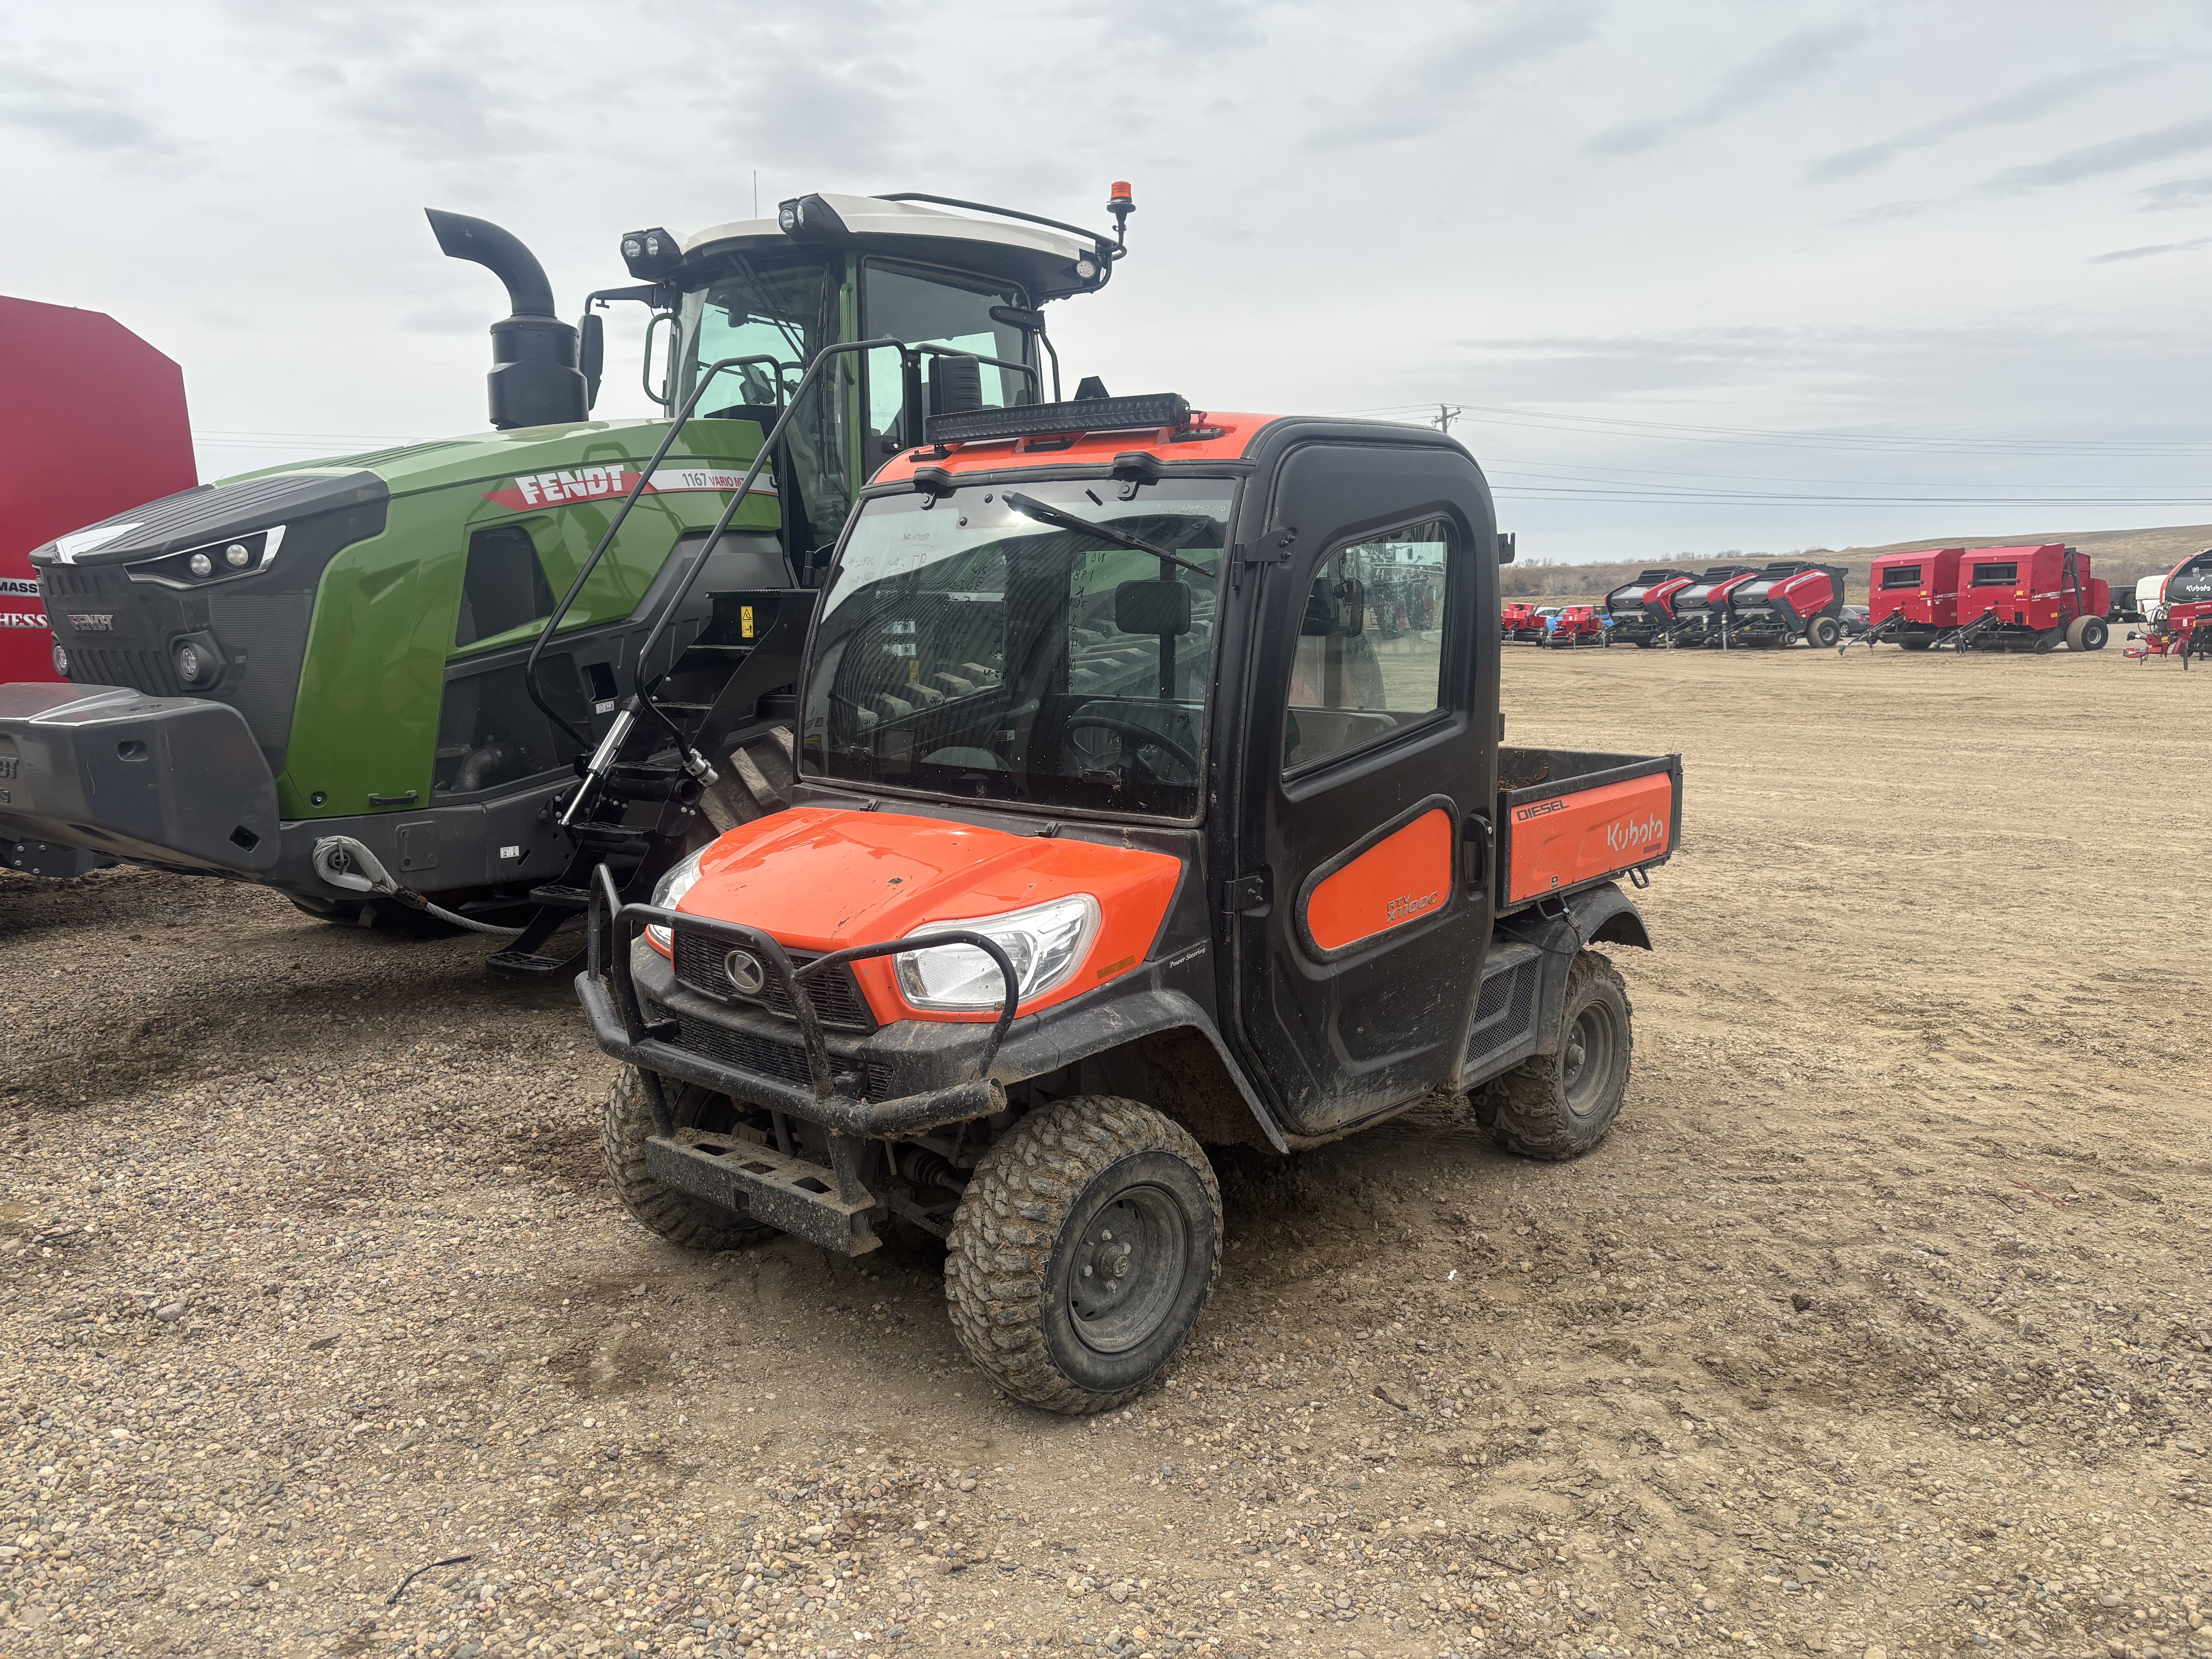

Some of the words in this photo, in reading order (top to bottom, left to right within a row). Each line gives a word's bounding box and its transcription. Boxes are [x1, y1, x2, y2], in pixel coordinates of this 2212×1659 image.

[515, 465, 624, 505] FENDT
[682, 473, 707, 486] 1167
[709, 476, 733, 487] VARIO
[67, 615, 113, 631] FENDT
[1516, 800, 1570, 821] DIESEL
[1607, 814, 1663, 852] Kubota
[1386, 891, 1438, 923] X1100C
[1387, 893, 1412, 911] RTV
[1170, 957, 1186, 968] Power
[1186, 948, 1206, 960] Steering
